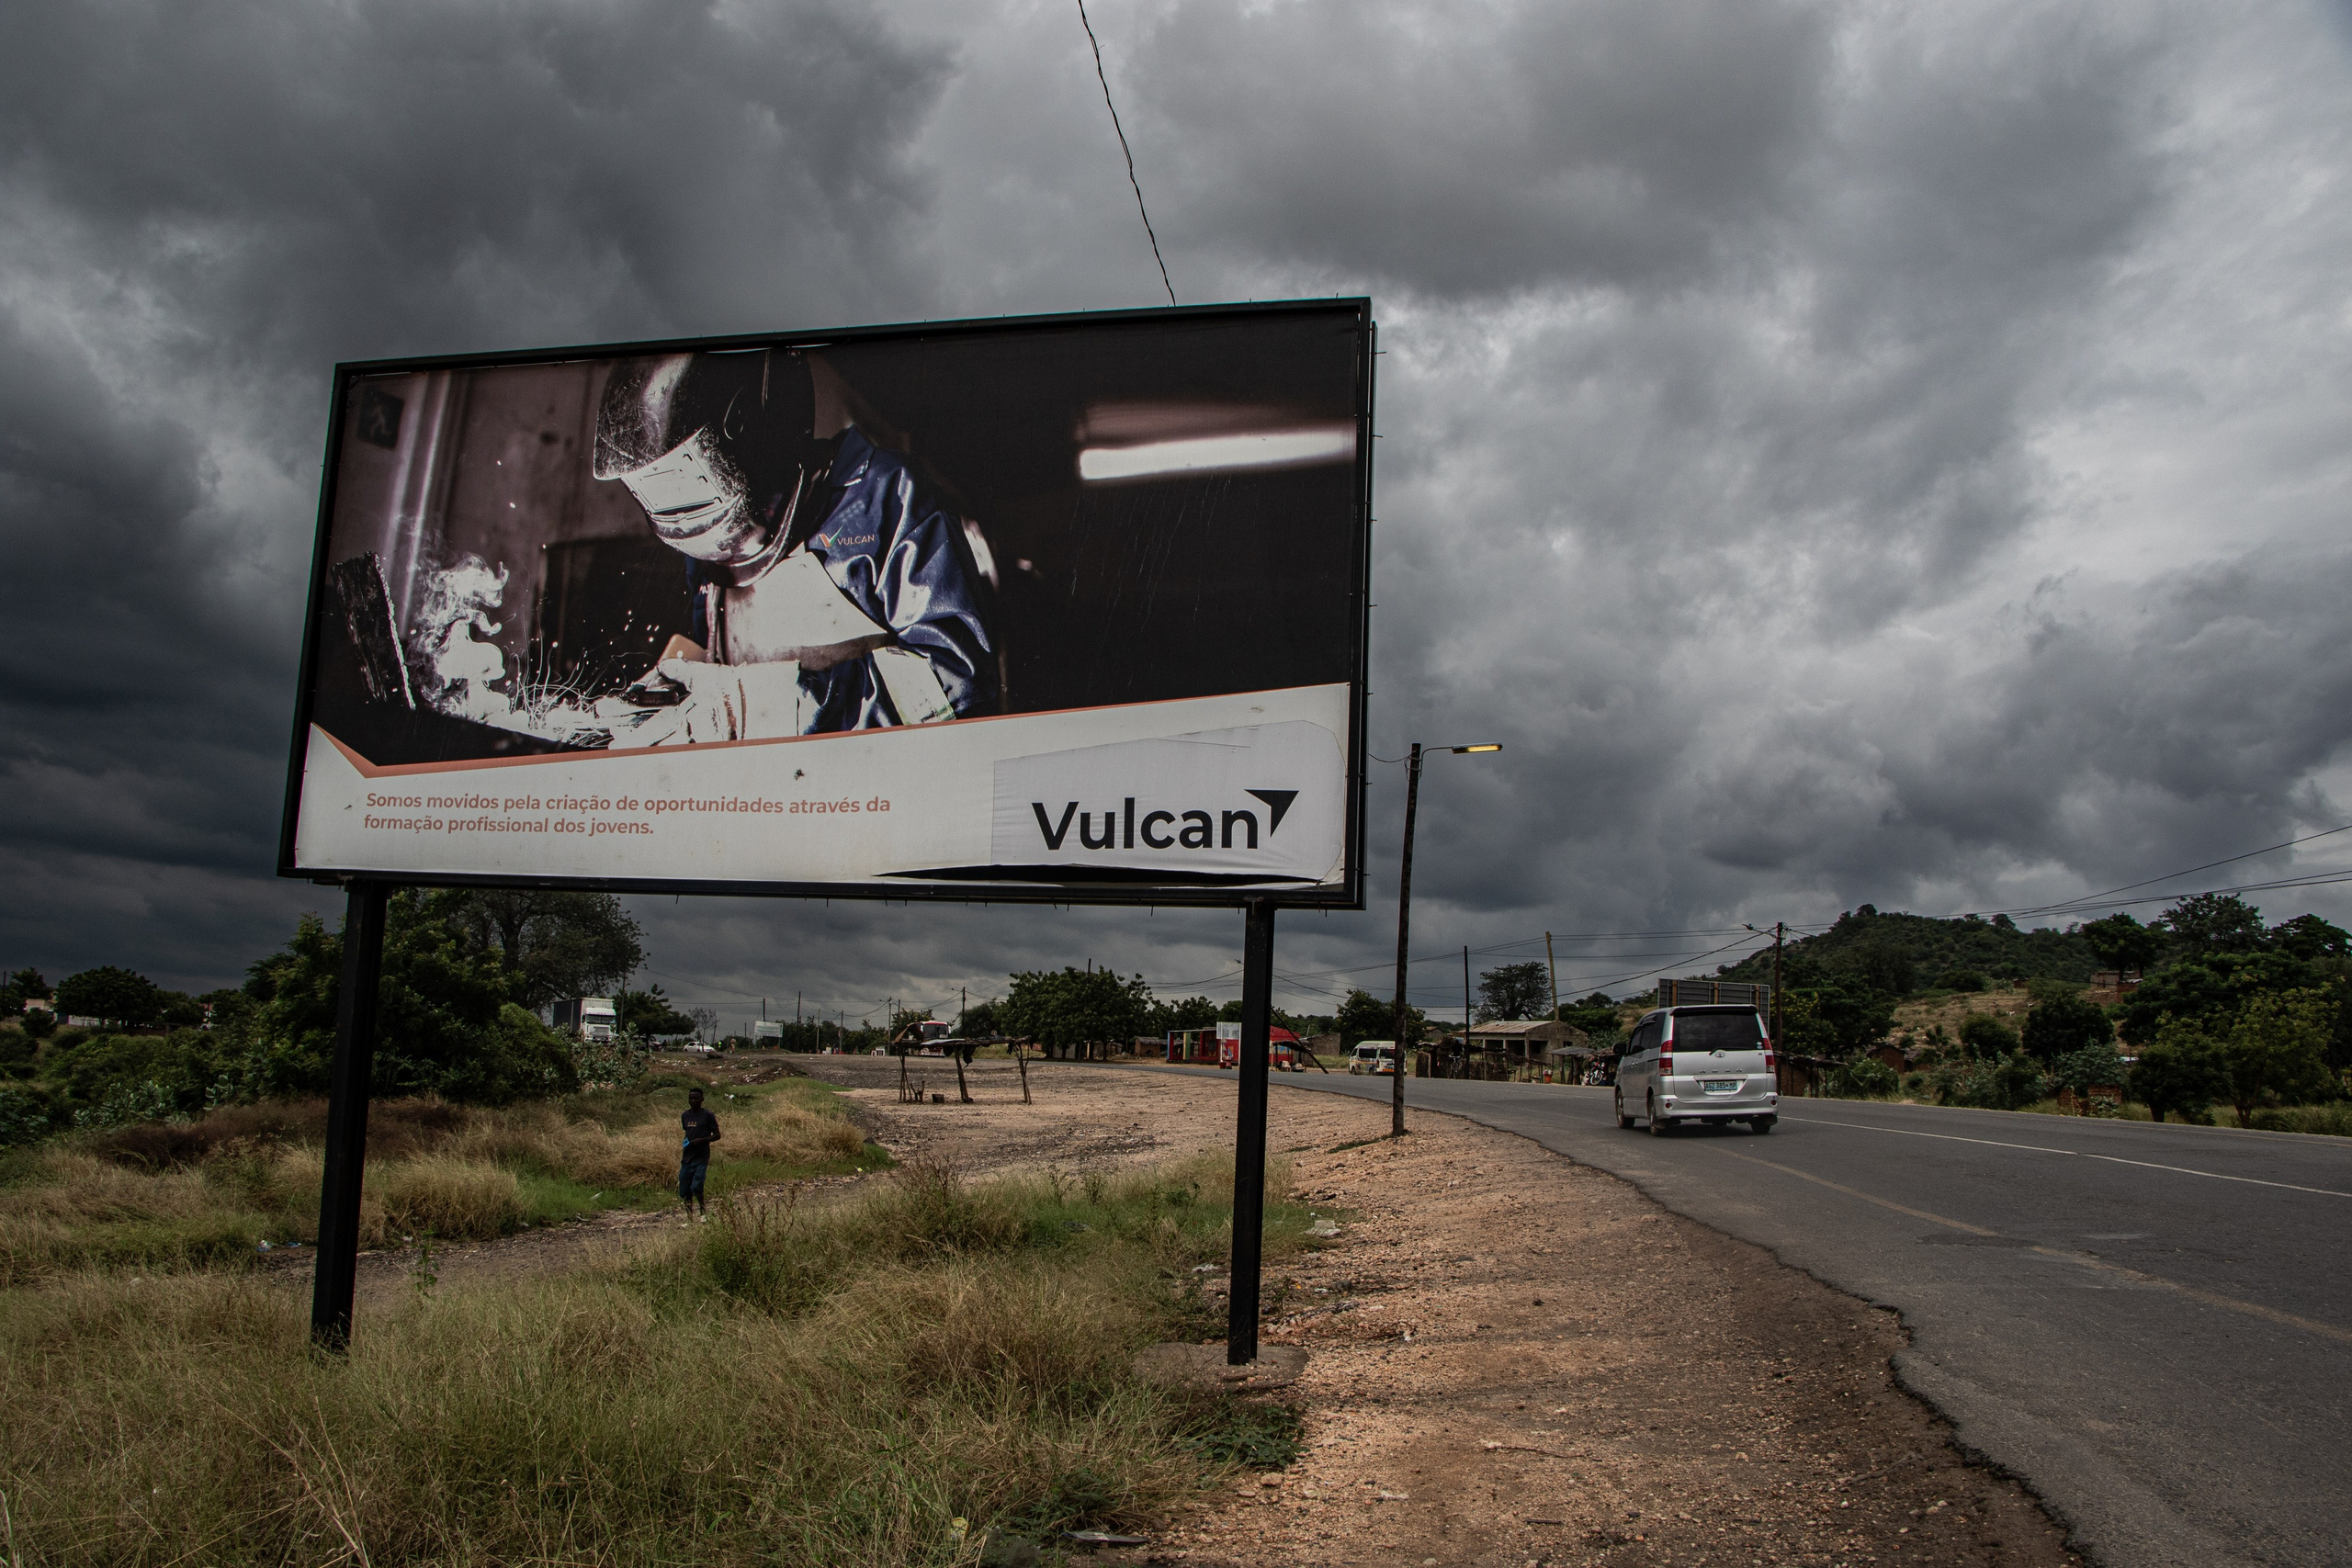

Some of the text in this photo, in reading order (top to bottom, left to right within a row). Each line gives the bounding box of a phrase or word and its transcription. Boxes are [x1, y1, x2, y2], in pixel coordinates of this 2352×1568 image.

[837, 534, 875, 546] VULCAN
[367, 793, 891, 815] Somos movidos pela criação de oportunidades através da
[364, 814, 654, 837] formação profissional dos jovens.
[1031, 796, 1259, 851] Vulcan
